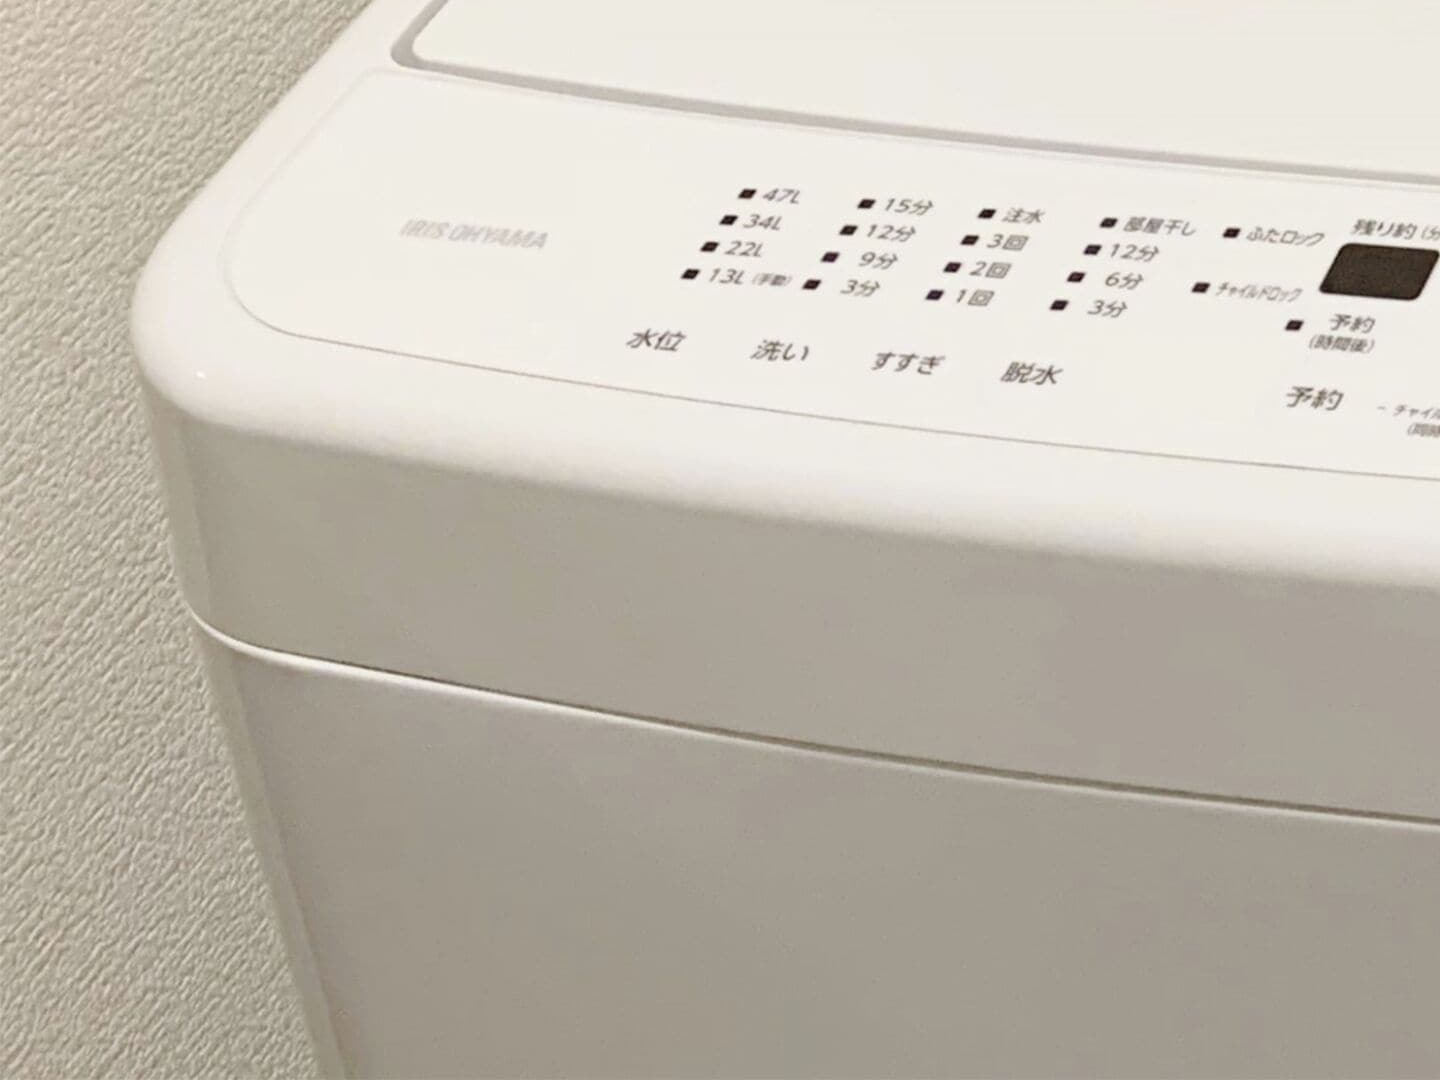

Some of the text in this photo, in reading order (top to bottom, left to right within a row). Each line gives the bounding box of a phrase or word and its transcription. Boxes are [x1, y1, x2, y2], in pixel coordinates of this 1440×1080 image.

[763, 188, 800, 204] 47L
[885, 198, 933, 216] 15分
[743, 214, 782, 231] 34L
[1123, 217, 1195, 236] 部屋干し
[867, 224, 916, 242] 12分
[1246, 227, 1325, 246] ふたロック
[724, 240, 763, 257] 22L
[987, 234, 1029, 251] 3回
[859, 252, 898, 270] 9分
[1111, 243, 1159, 262] 12分
[969, 261, 1012, 279] 2回
[840, 279, 880, 297] 3分
[1105, 272, 1144, 290] 6分
[956, 289, 995, 307] 1回
[1087, 300, 1128, 318] 3分
[1331, 314, 1375, 333] 予約
[626, 328, 687, 352] 水位
[750, 339, 809, 362] 洗い
[871, 352, 946, 375] すすぎ
[1000, 362, 1063, 386] 脱水
[1287, 387, 1344, 411] 予約
